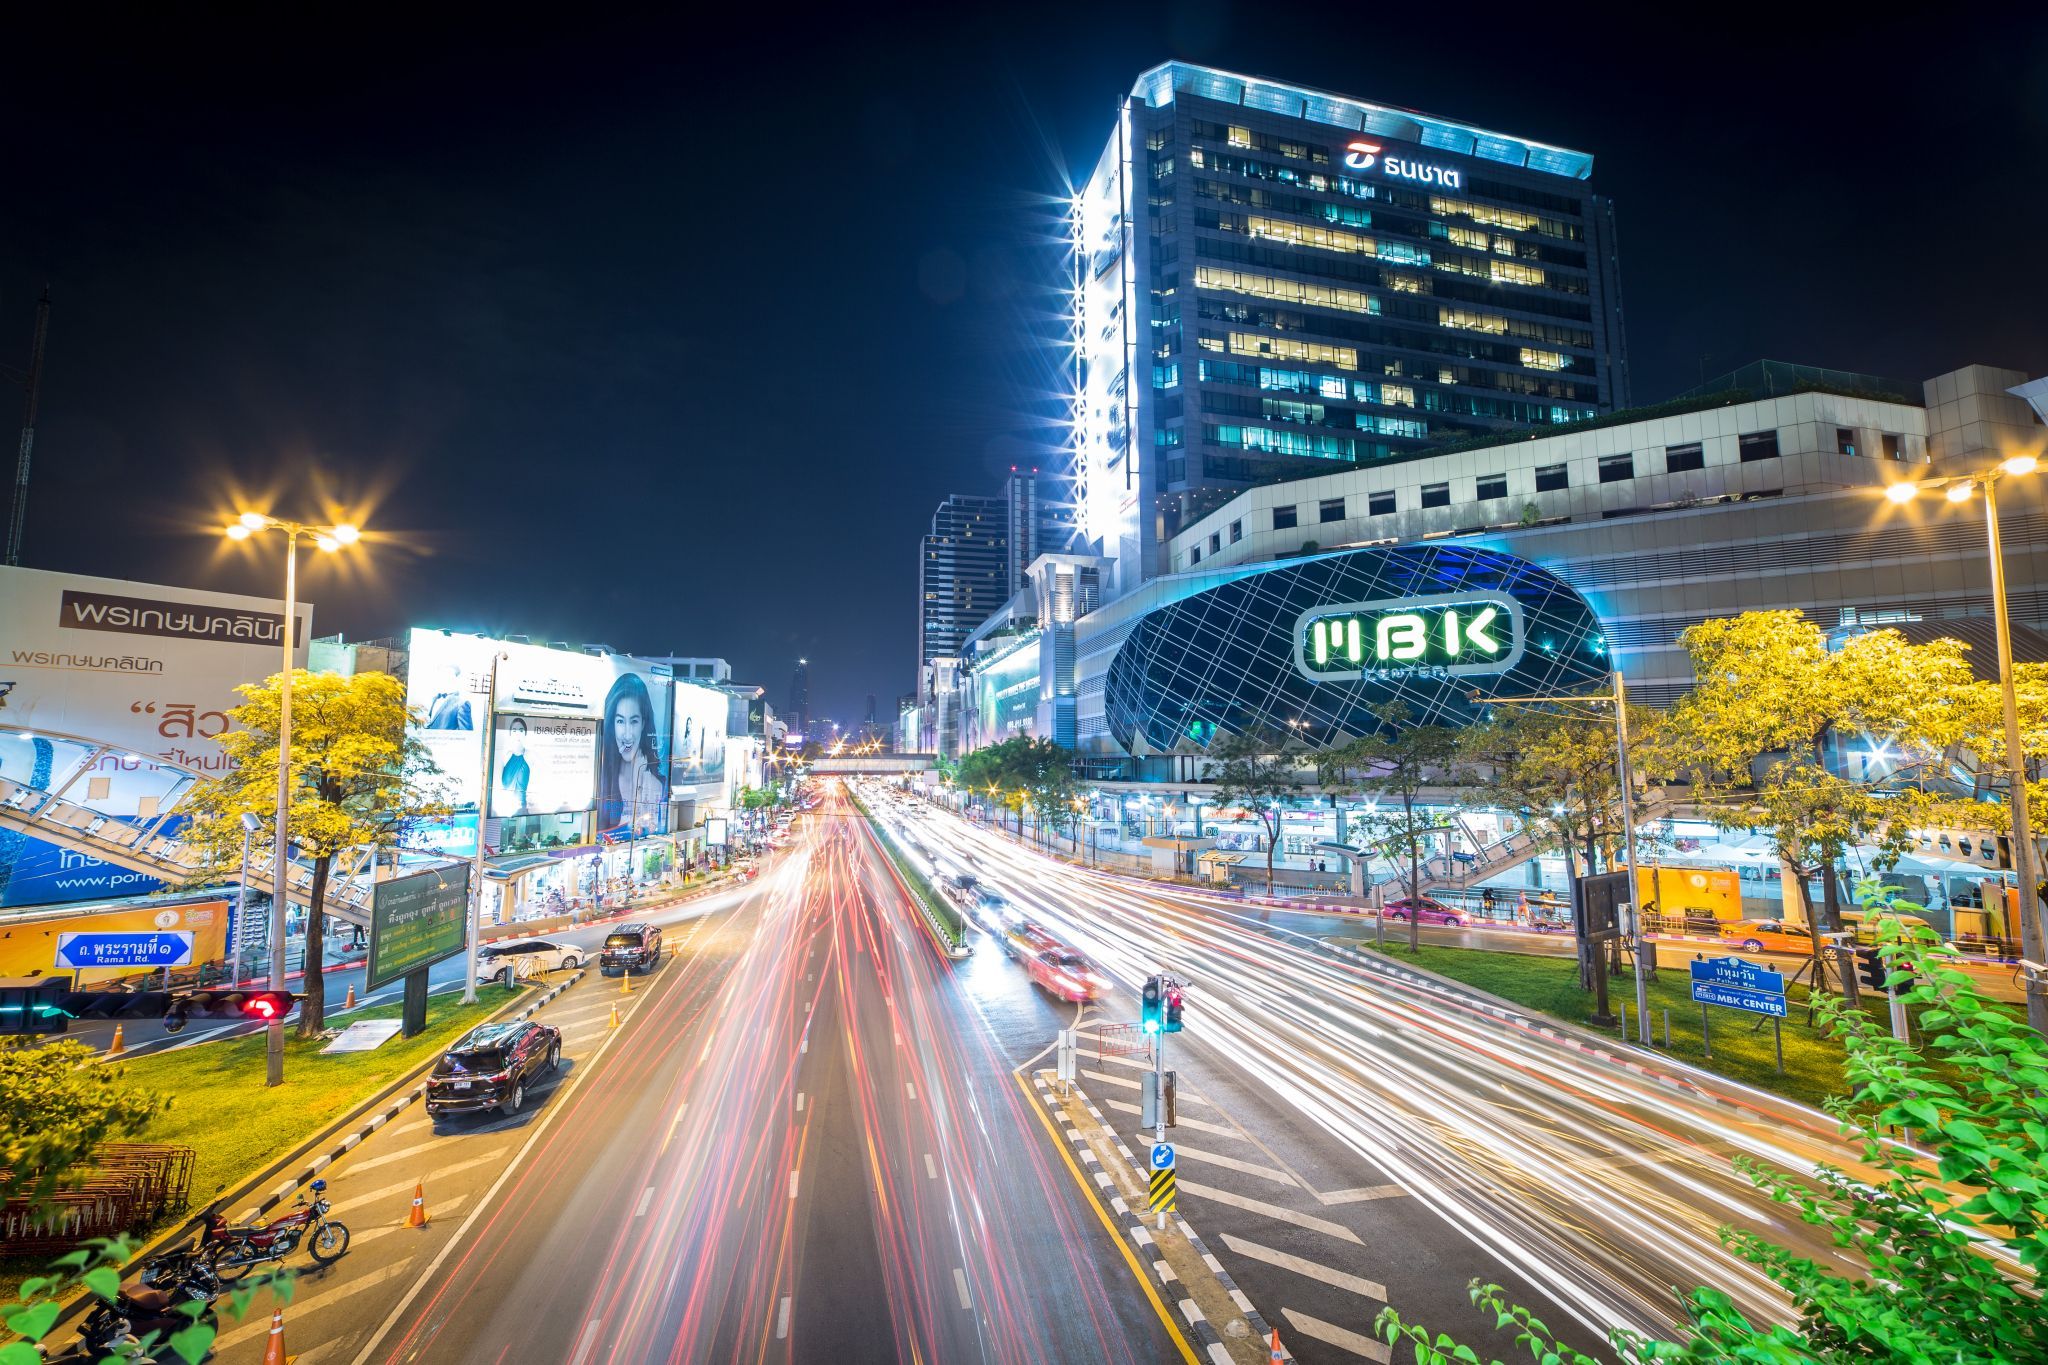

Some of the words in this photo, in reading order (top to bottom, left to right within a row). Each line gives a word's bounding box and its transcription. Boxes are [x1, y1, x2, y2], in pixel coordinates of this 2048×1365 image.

[1384, 157, 1460, 188] ธนชาต
[1314, 607, 1499, 664] MBK
[12, 650, 163, 672] พรเกษมคลินิก
[1364, 666, 1446, 681] CENTER
[80, 945, 90, 956] ถ.
[94, 935, 158, 955] พระรามที่
[159, 944, 171, 955] ๑
[97, 956, 124, 964] Rama
[1716, 967, 1755, 980] ปทุมวัน
[1717, 994, 1741, 1005] MBK
[1743, 999, 1783, 1013] CENTER
